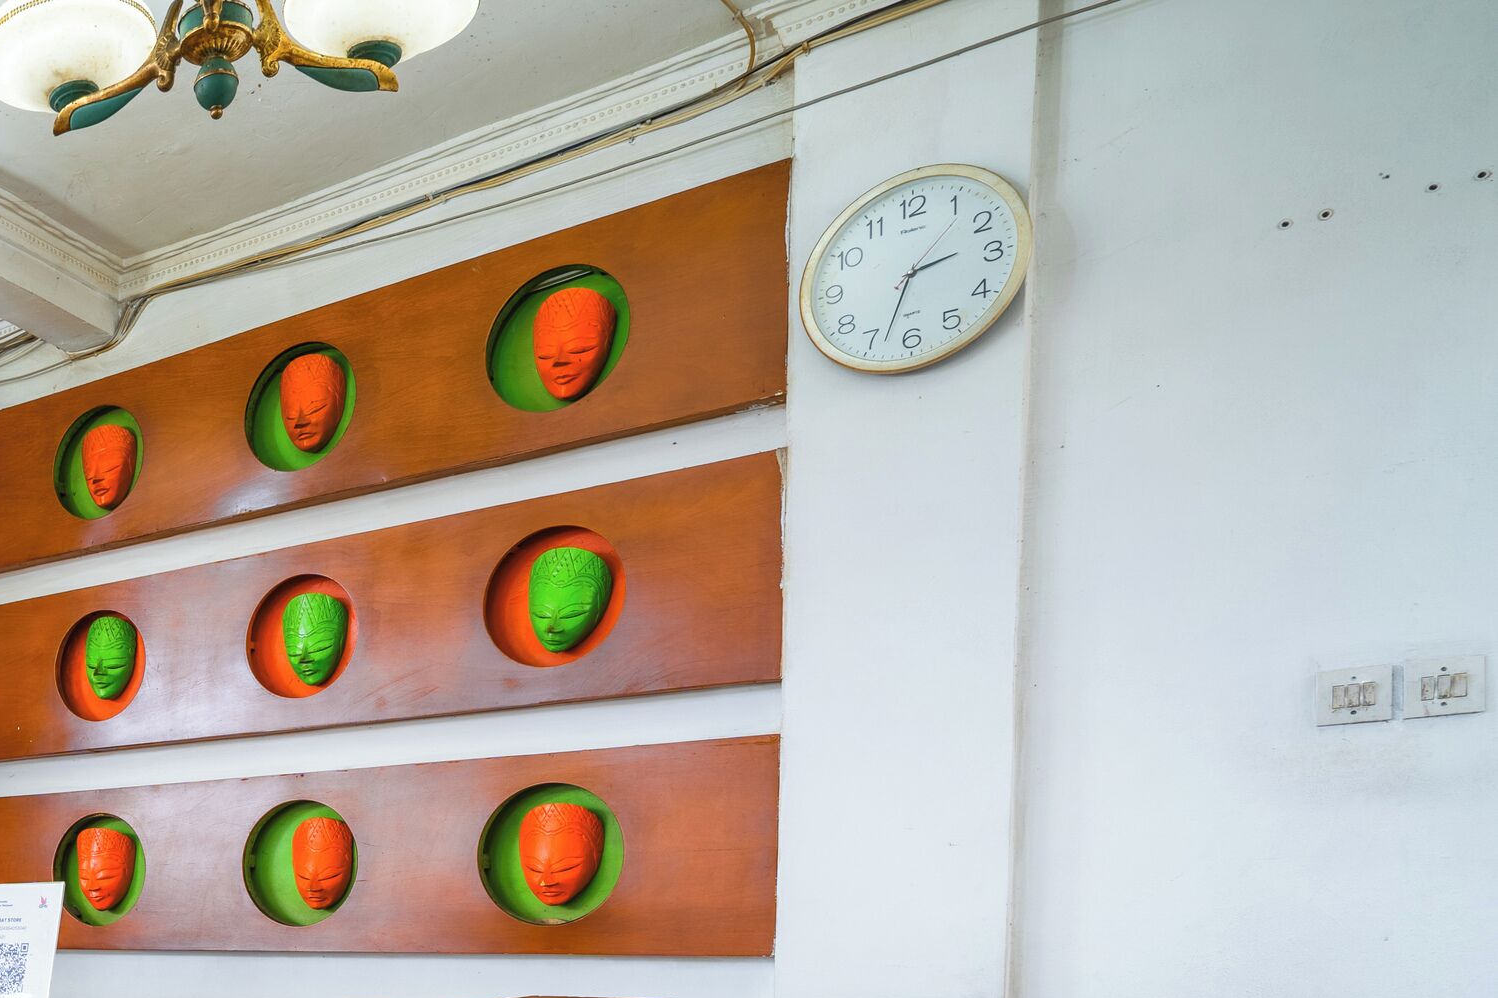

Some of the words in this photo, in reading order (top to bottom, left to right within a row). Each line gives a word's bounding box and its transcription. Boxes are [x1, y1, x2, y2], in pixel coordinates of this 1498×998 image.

[899, 194, 927, 220] 12
[950, 194, 958, 216] 1
[865, 216, 885, 240] 11
[972, 210, 993, 234] 2
[837, 246, 864, 271] 10
[982, 240, 1004, 262] 3
[825, 284, 844, 305] 9
[971, 278, 992, 299] 4
[837, 313, 856, 335] 8
[942, 308, 962, 330] 5
[862, 328, 881, 350] 7
[902, 327, 922, 349] 6
